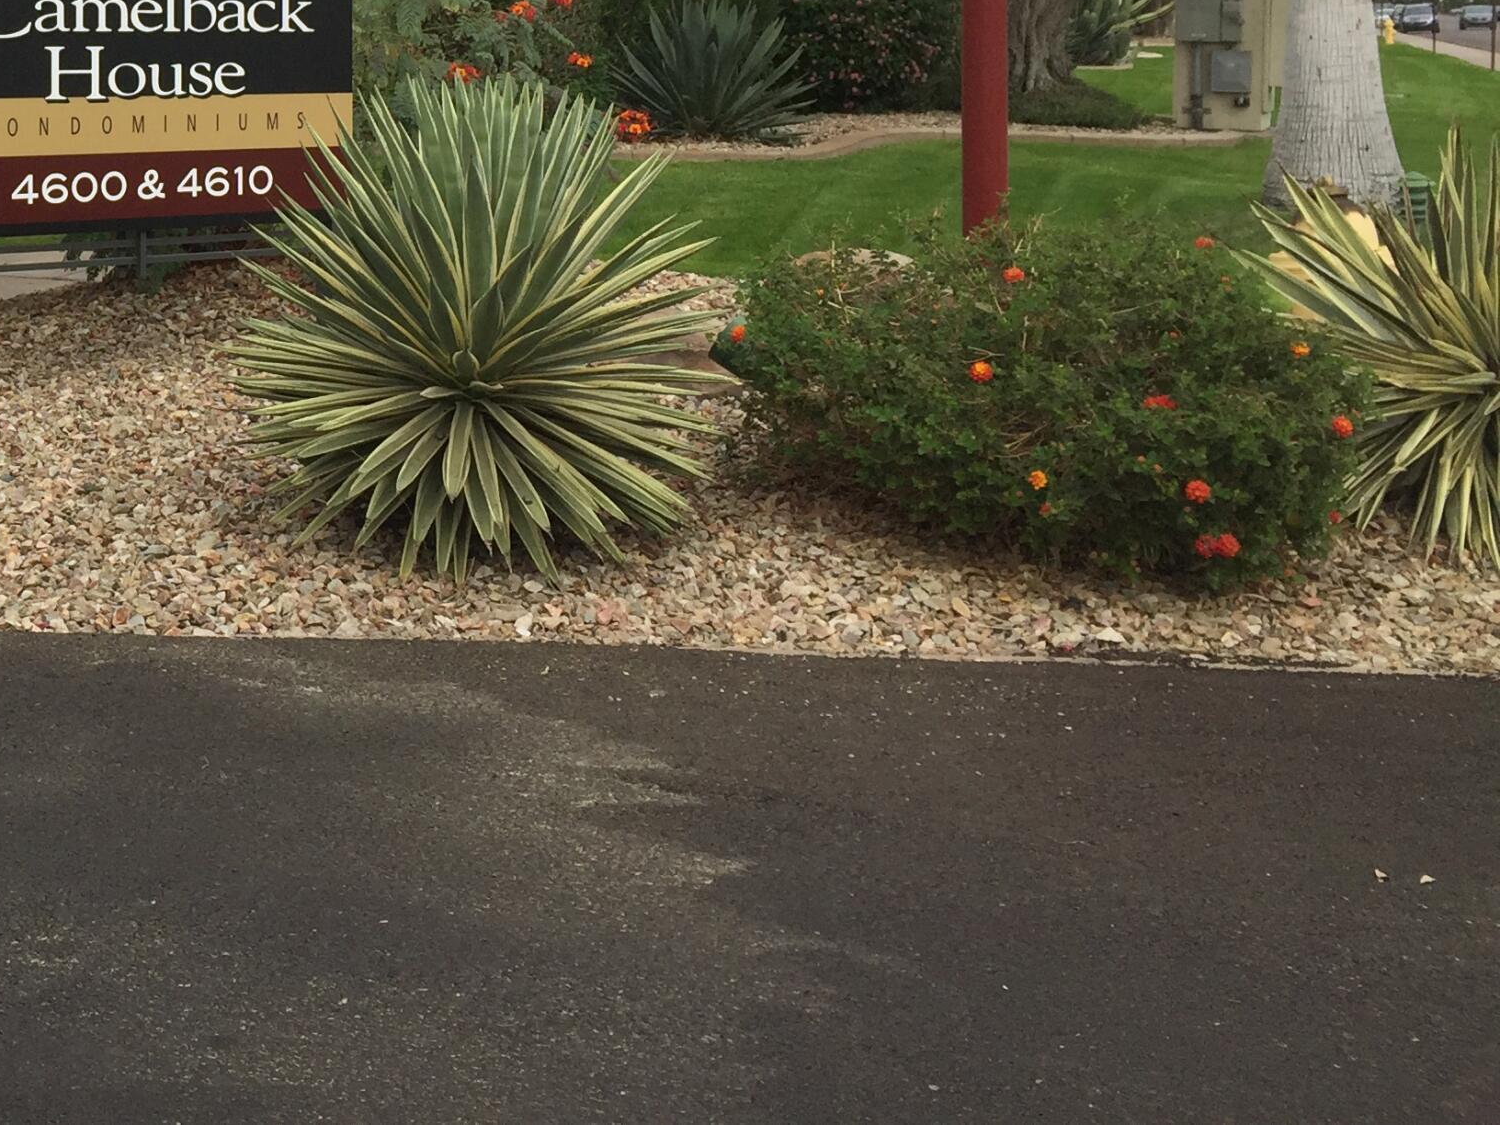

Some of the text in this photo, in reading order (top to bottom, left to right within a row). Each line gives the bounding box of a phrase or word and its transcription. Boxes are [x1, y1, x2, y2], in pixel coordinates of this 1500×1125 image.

[44, 45, 246, 101] House
[11, 165, 274, 205] 4600 & 4610
